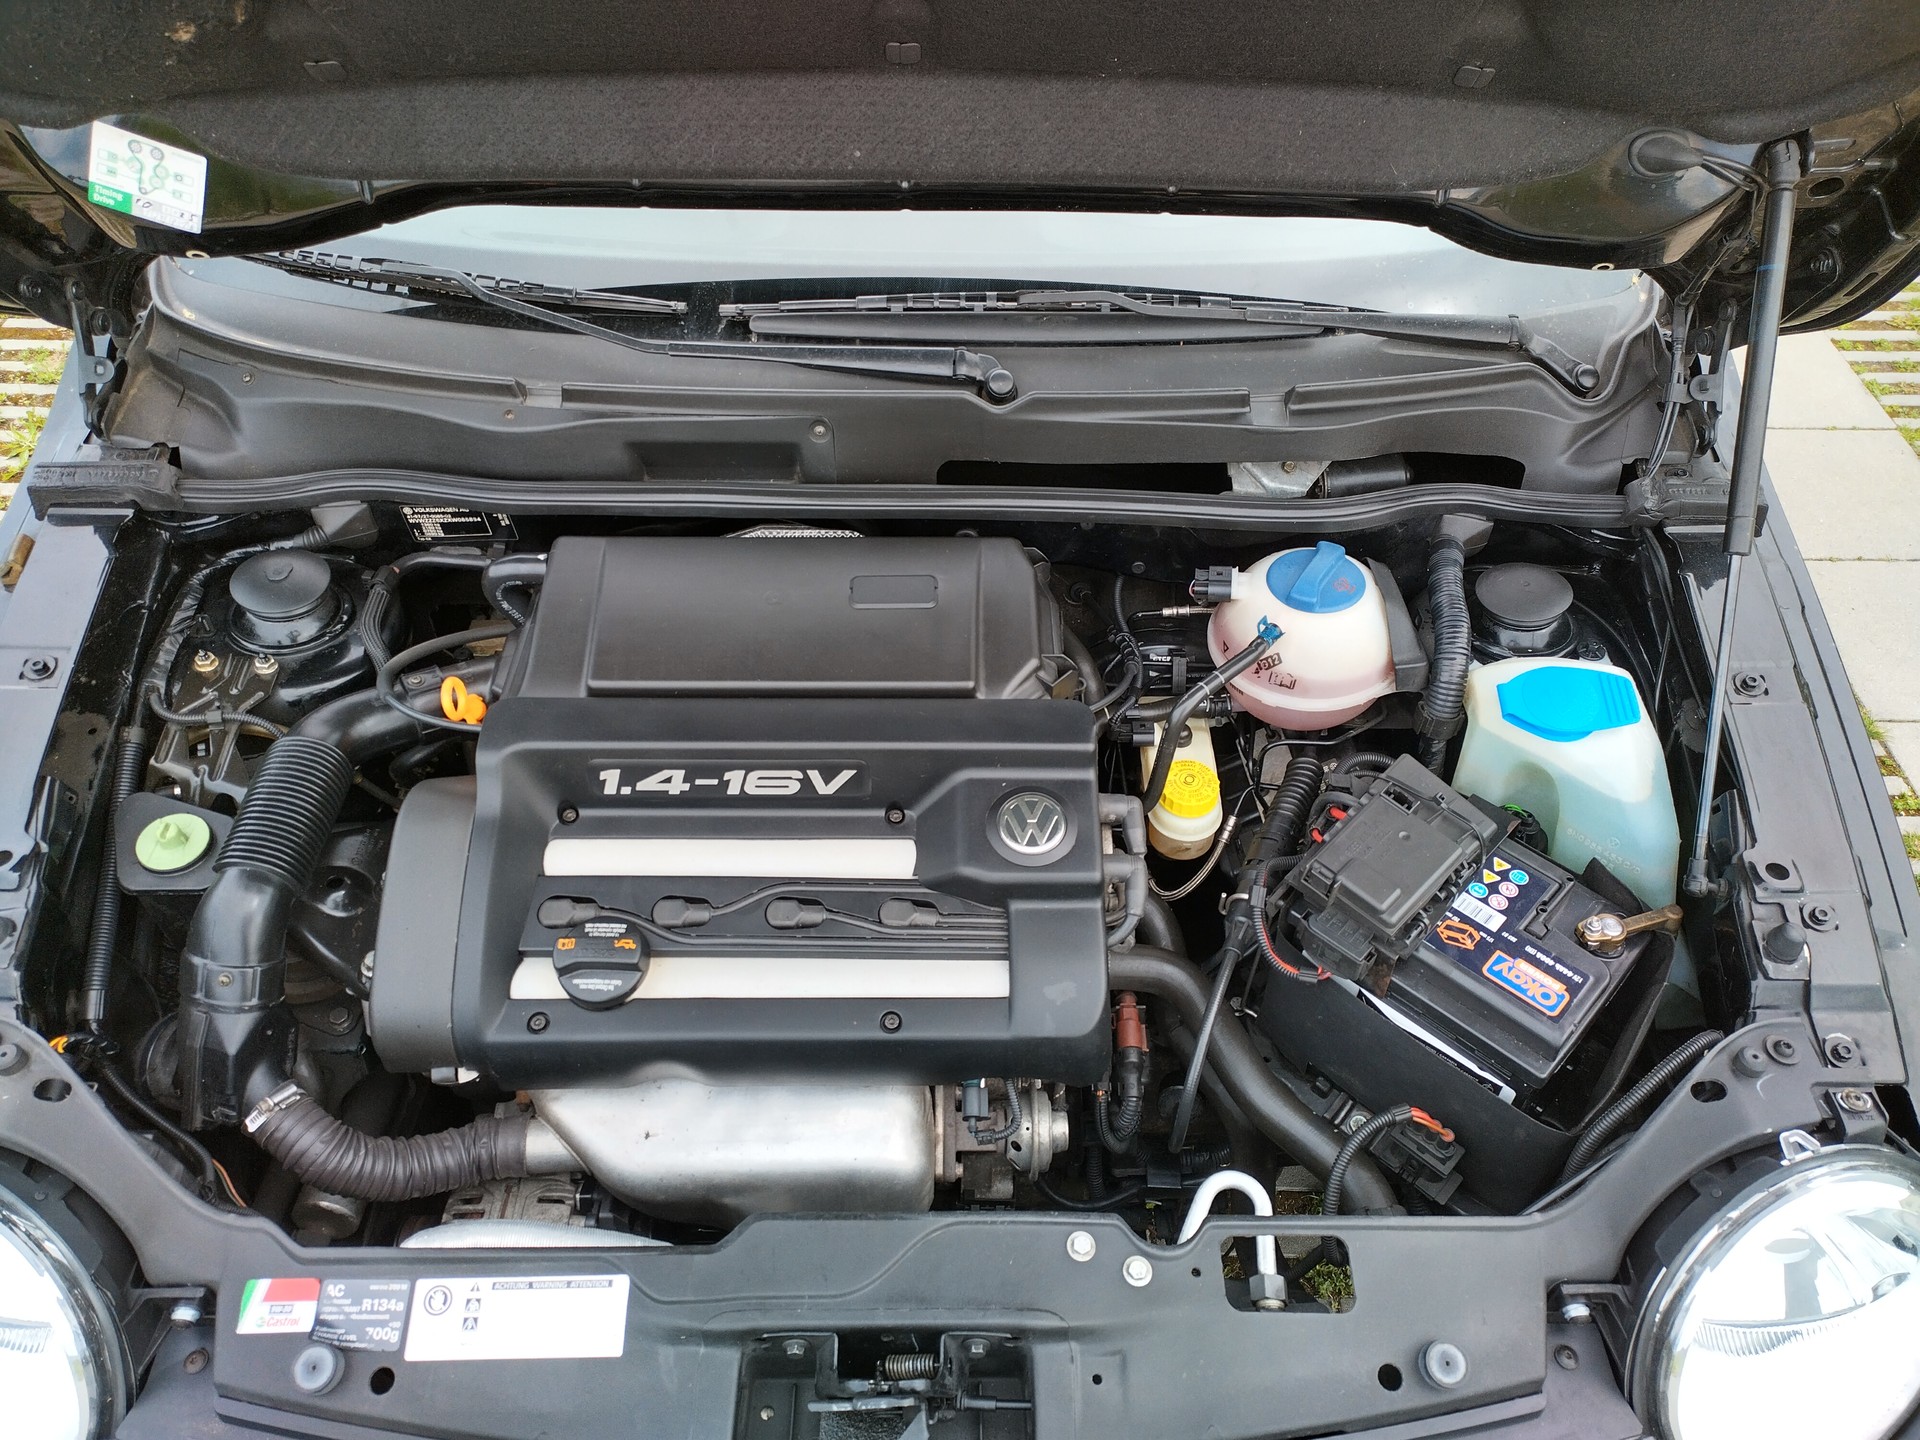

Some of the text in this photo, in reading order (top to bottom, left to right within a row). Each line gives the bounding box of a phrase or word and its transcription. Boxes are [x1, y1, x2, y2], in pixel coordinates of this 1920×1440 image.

[93, 192, 115, 205] Drive
[94, 184, 123, 201] Timing
[599, 768, 857, 796] 1.4-16V
[1492, 959, 1559, 1007] Okay
[1518, 961, 1560, 988] POWER
[494, 1280, 609, 1290] ACHTUNG WARNING ATTENTION
[361, 1298, 404, 1312] R134a
[266, 1316, 301, 1328] Castrol
[365, 1326, 400, 1343] 700g
